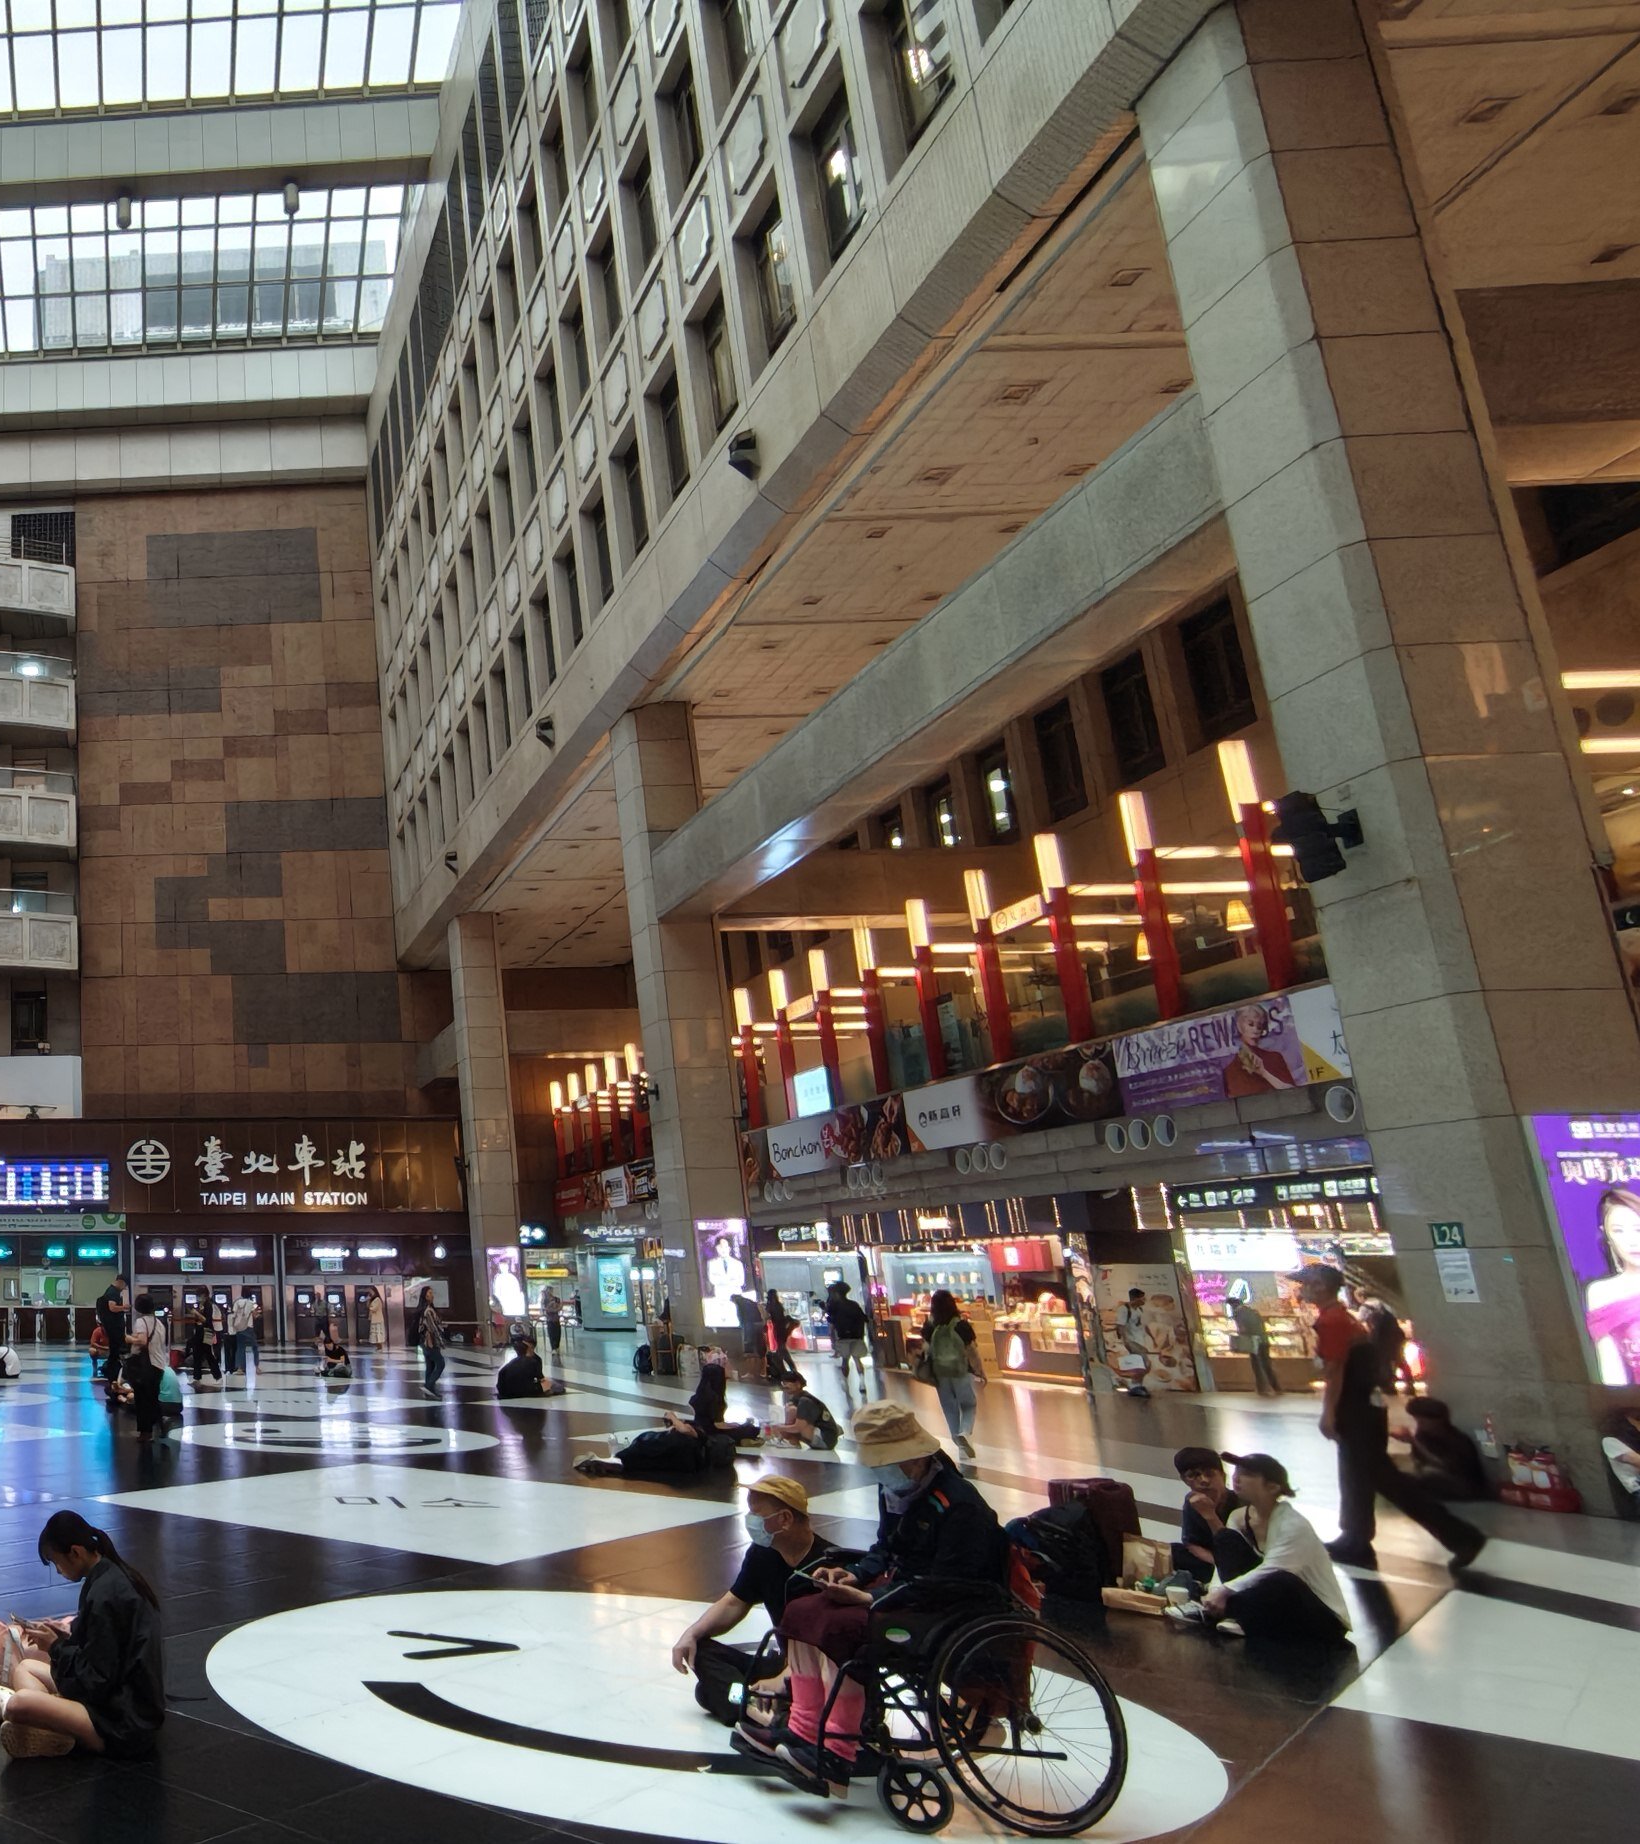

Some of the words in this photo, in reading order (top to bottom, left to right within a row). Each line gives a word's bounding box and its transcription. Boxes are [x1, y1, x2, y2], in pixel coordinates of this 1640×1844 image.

[1188, 1006, 1284, 1055] REWAS
[1309, 1066, 1325, 1081] 1F
[194, 1134, 366, 1186] 臺北車站
[200, 1192, 247, 1206] TAIPEI
[256, 1192, 295, 1206] MAIN
[303, 1191, 368, 1206] STATION
[1432, 1225, 1462, 1245] L24
[334, 1496, 501, 1509] 미소
